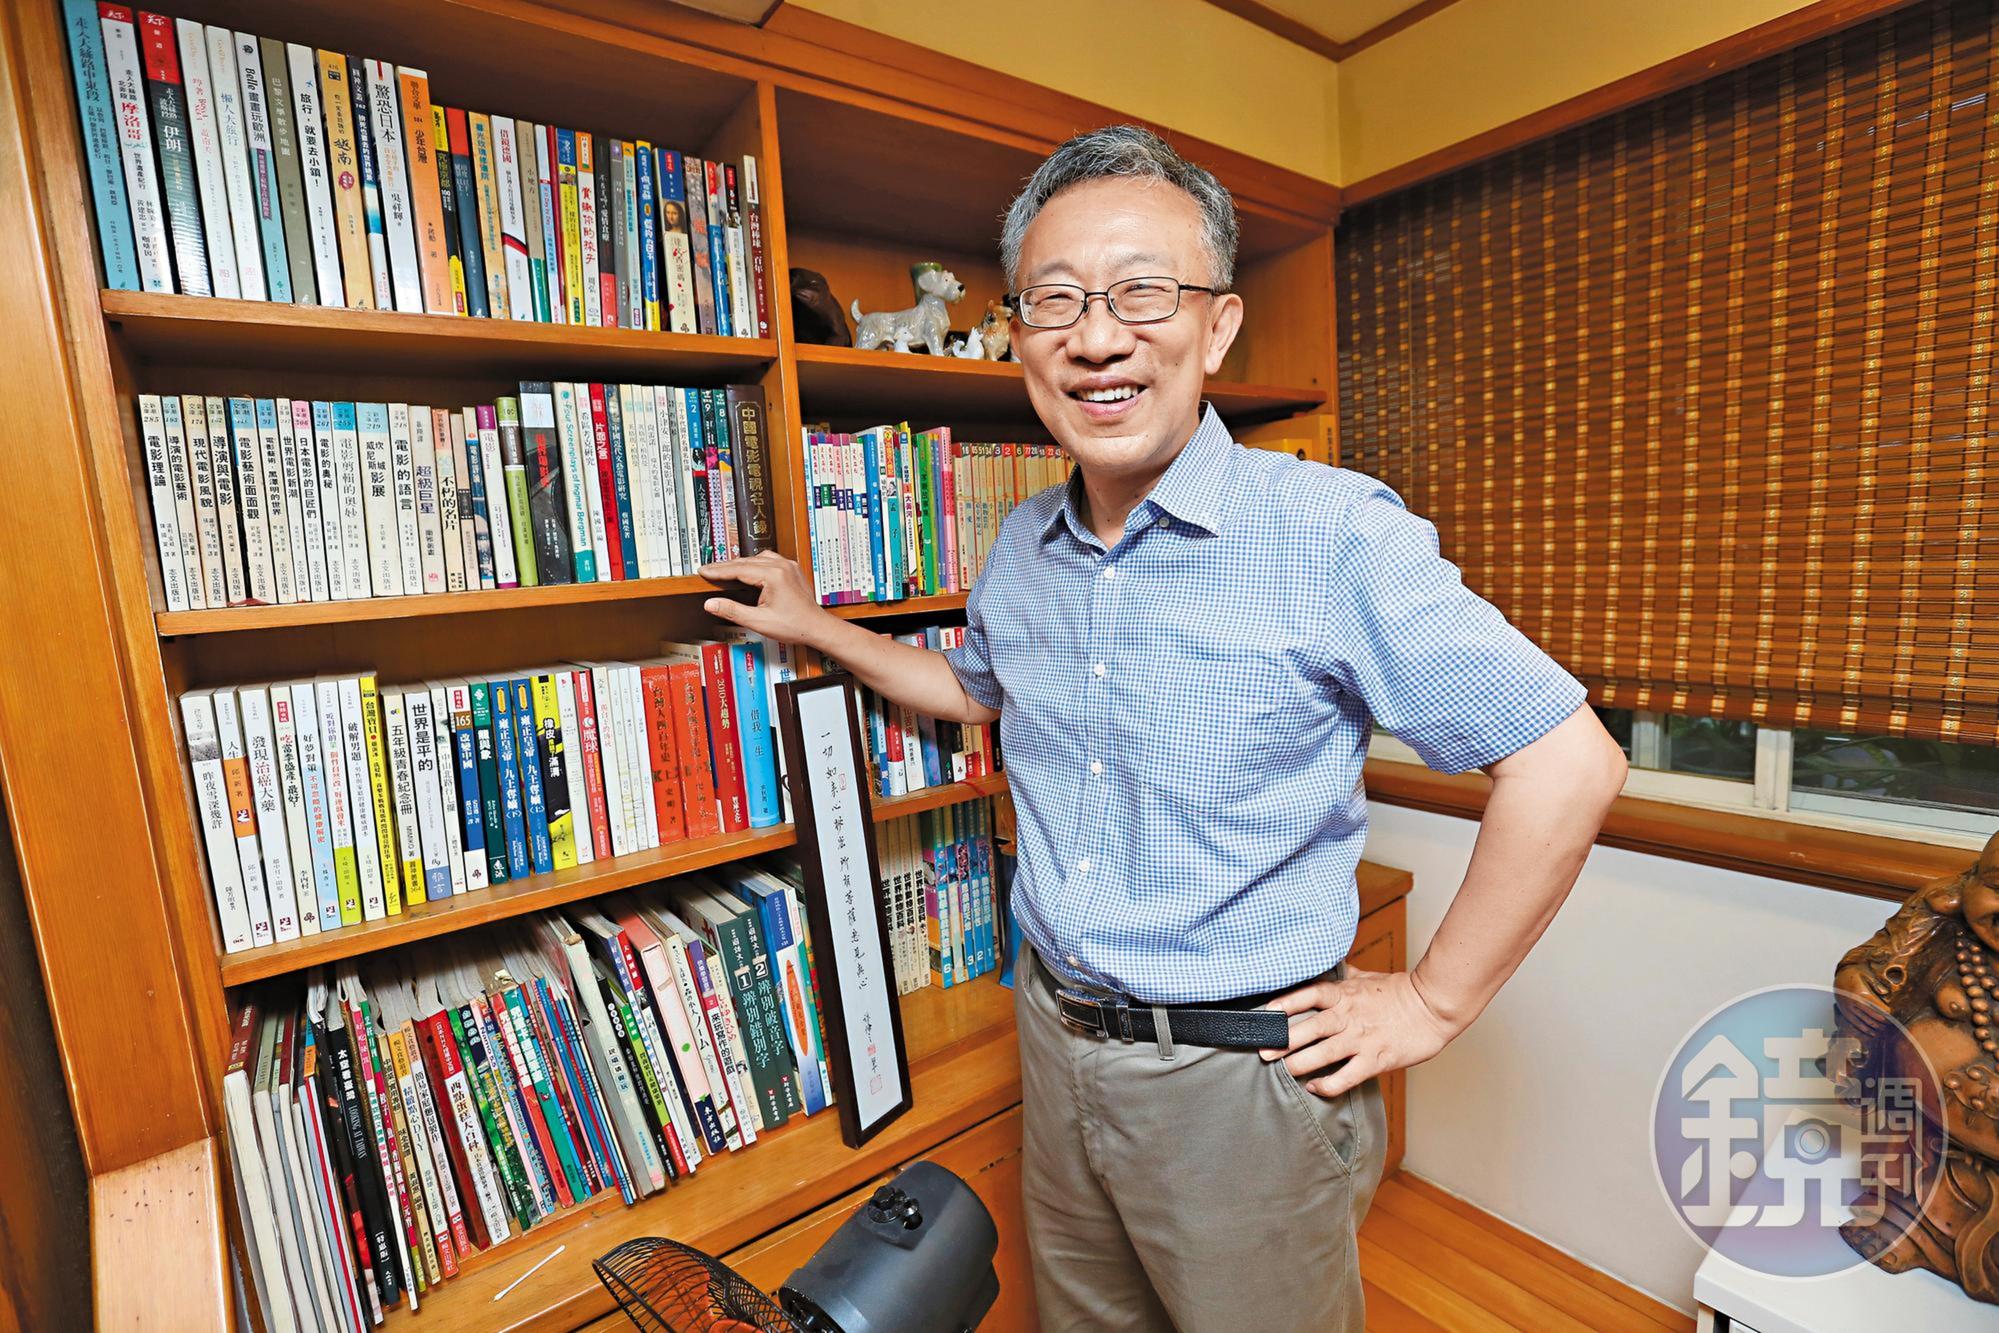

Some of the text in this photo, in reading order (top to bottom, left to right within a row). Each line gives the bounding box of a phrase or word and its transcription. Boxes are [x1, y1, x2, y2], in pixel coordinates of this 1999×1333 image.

[245, 67, 258, 91] Belle
[121, 102, 141, 140] 摩洛哥
[163, 125, 181, 152] 伊朗
[375, 84, 396, 143] 驚恐日本
[333, 138, 352, 165] 越南
[581, 187, 596, 265] 賞識你的孩子
[691, 404, 697, 413] 2
[704, 404, 711, 412] 9
[719, 408, 726, 418] 8
[147, 435, 167, 487] 電影理論
[168, 435, 188, 501] 導演的電影藝術
[193, 438, 213, 508] 現代電影風貌
[213, 435, 232, 506] 導演與電影
[238, 437, 259, 520] 電影藝術面面觀
[283, 435, 298, 499] 世界電影新潮
[299, 437, 317, 519] 日本電影的巨匠們
[394, 439, 412, 511] 電影的語言
[659, 409, 674, 496] 小津安二郎的電影美學
[741, 407, 769, 534] 中國電影電視名人錄
[370, 470, 386, 498] 影展
[416, 464, 436, 515] 超級巨星
[441, 475, 458, 531] 不朽的名片
[577, 512, 587, 547] Bergman
[347, 722, 362, 761] 破解男題
[411, 703, 433, 772] 世界是平的
[455, 714, 471, 726] 165
[583, 728, 598, 753] 魔球
[750, 708, 764, 756] 借我一生
[252, 735, 276, 813] 發現治癌大藥
[303, 733, 317, 772] 好夢對策
[391, 724, 413, 816] 五年級青春紀念冊
[459, 733, 473, 770] 改變中國
[203, 771, 222, 830] 昨夜雪深幾許
[756, 963, 766, 976] 2
[742, 990, 771, 1067] 辨別錯別字
[757, 979, 785, 1056] 辨別破音字
[403, 1085, 424, 1151] 精緻點心DIY
[415, 1071, 439, 1143] 簡易家庭麵包製作
[450, 1078, 480, 1153] 西點蛋糕大百科
